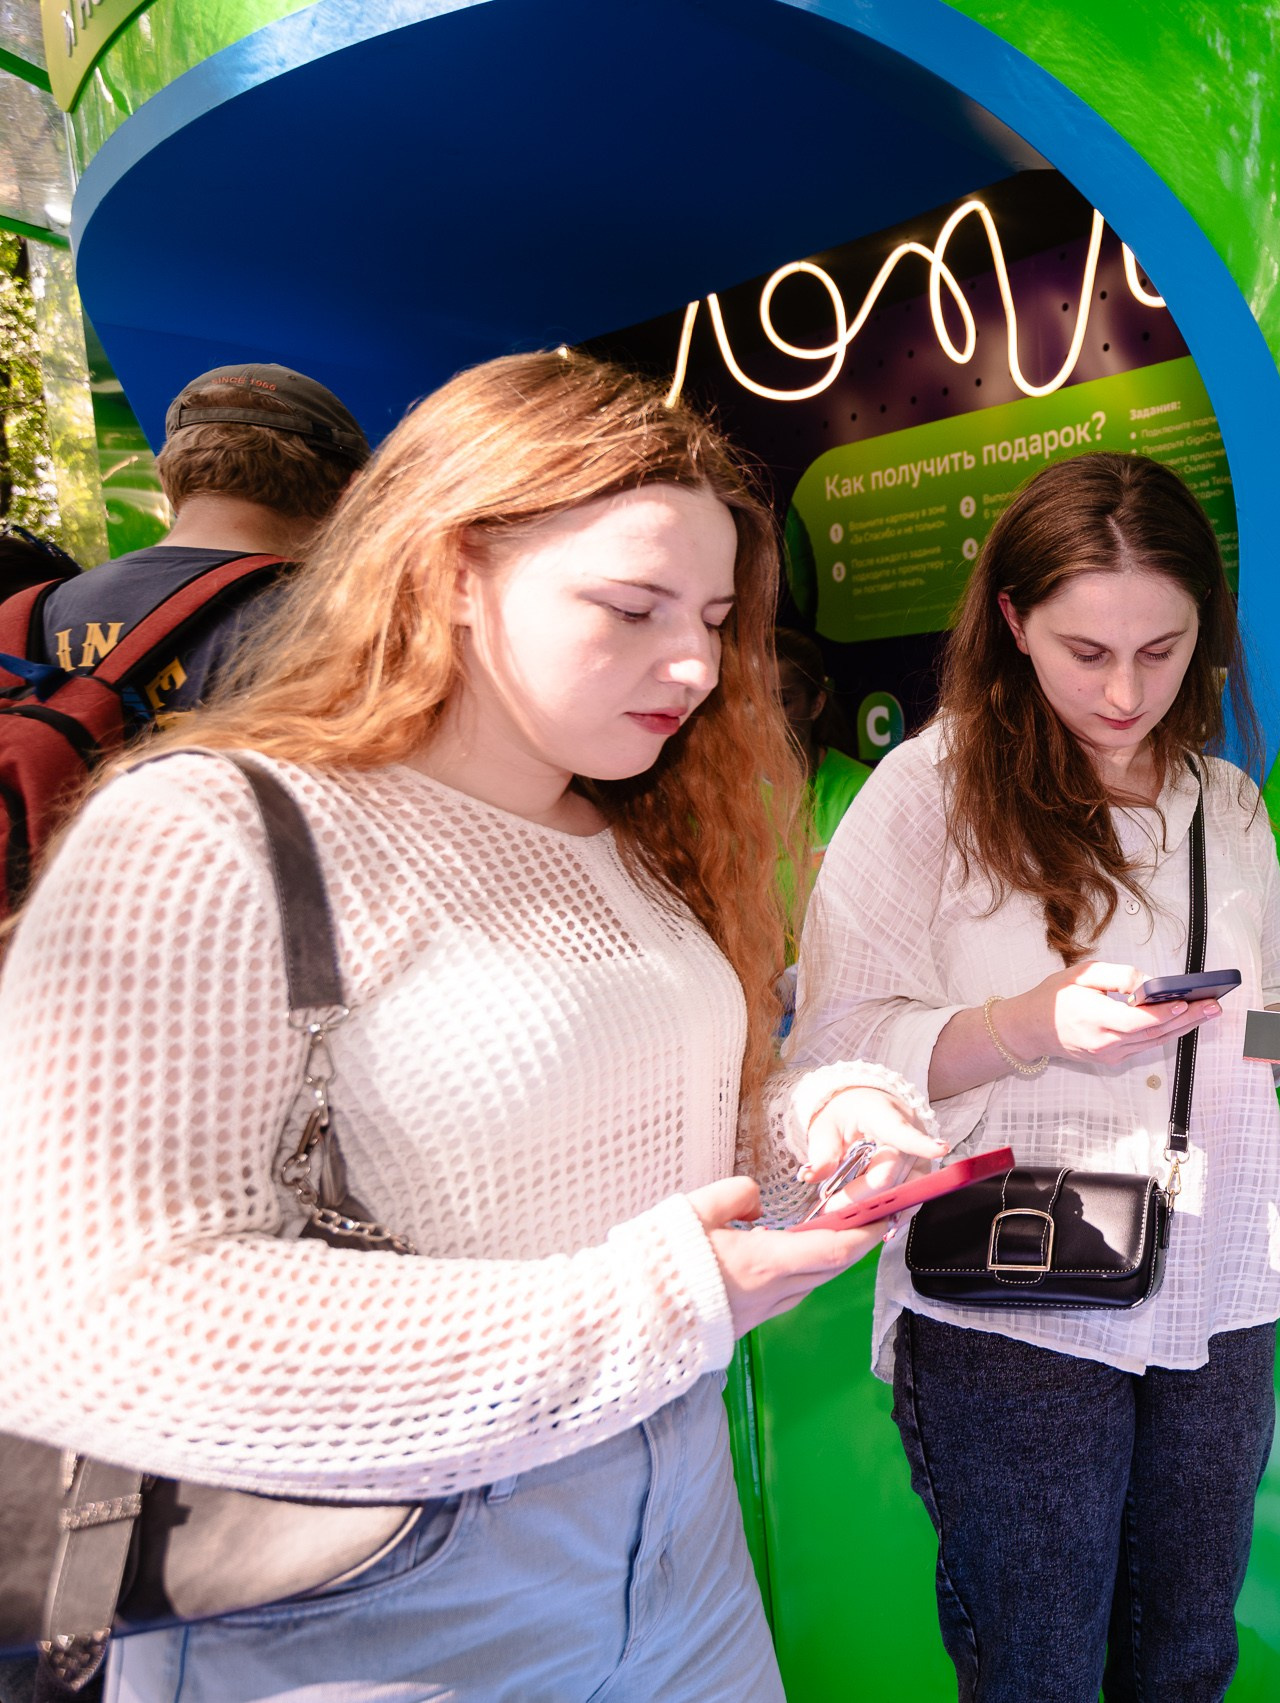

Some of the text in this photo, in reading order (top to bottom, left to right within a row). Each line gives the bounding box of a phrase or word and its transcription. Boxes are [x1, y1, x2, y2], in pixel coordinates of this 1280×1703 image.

[211, 376, 277, 391] SINCE 1966
[1129, 400, 1182, 421] Задания:
[824, 410, 1107, 502] Как получить подарок?
[866, 705, 891, 747] С
